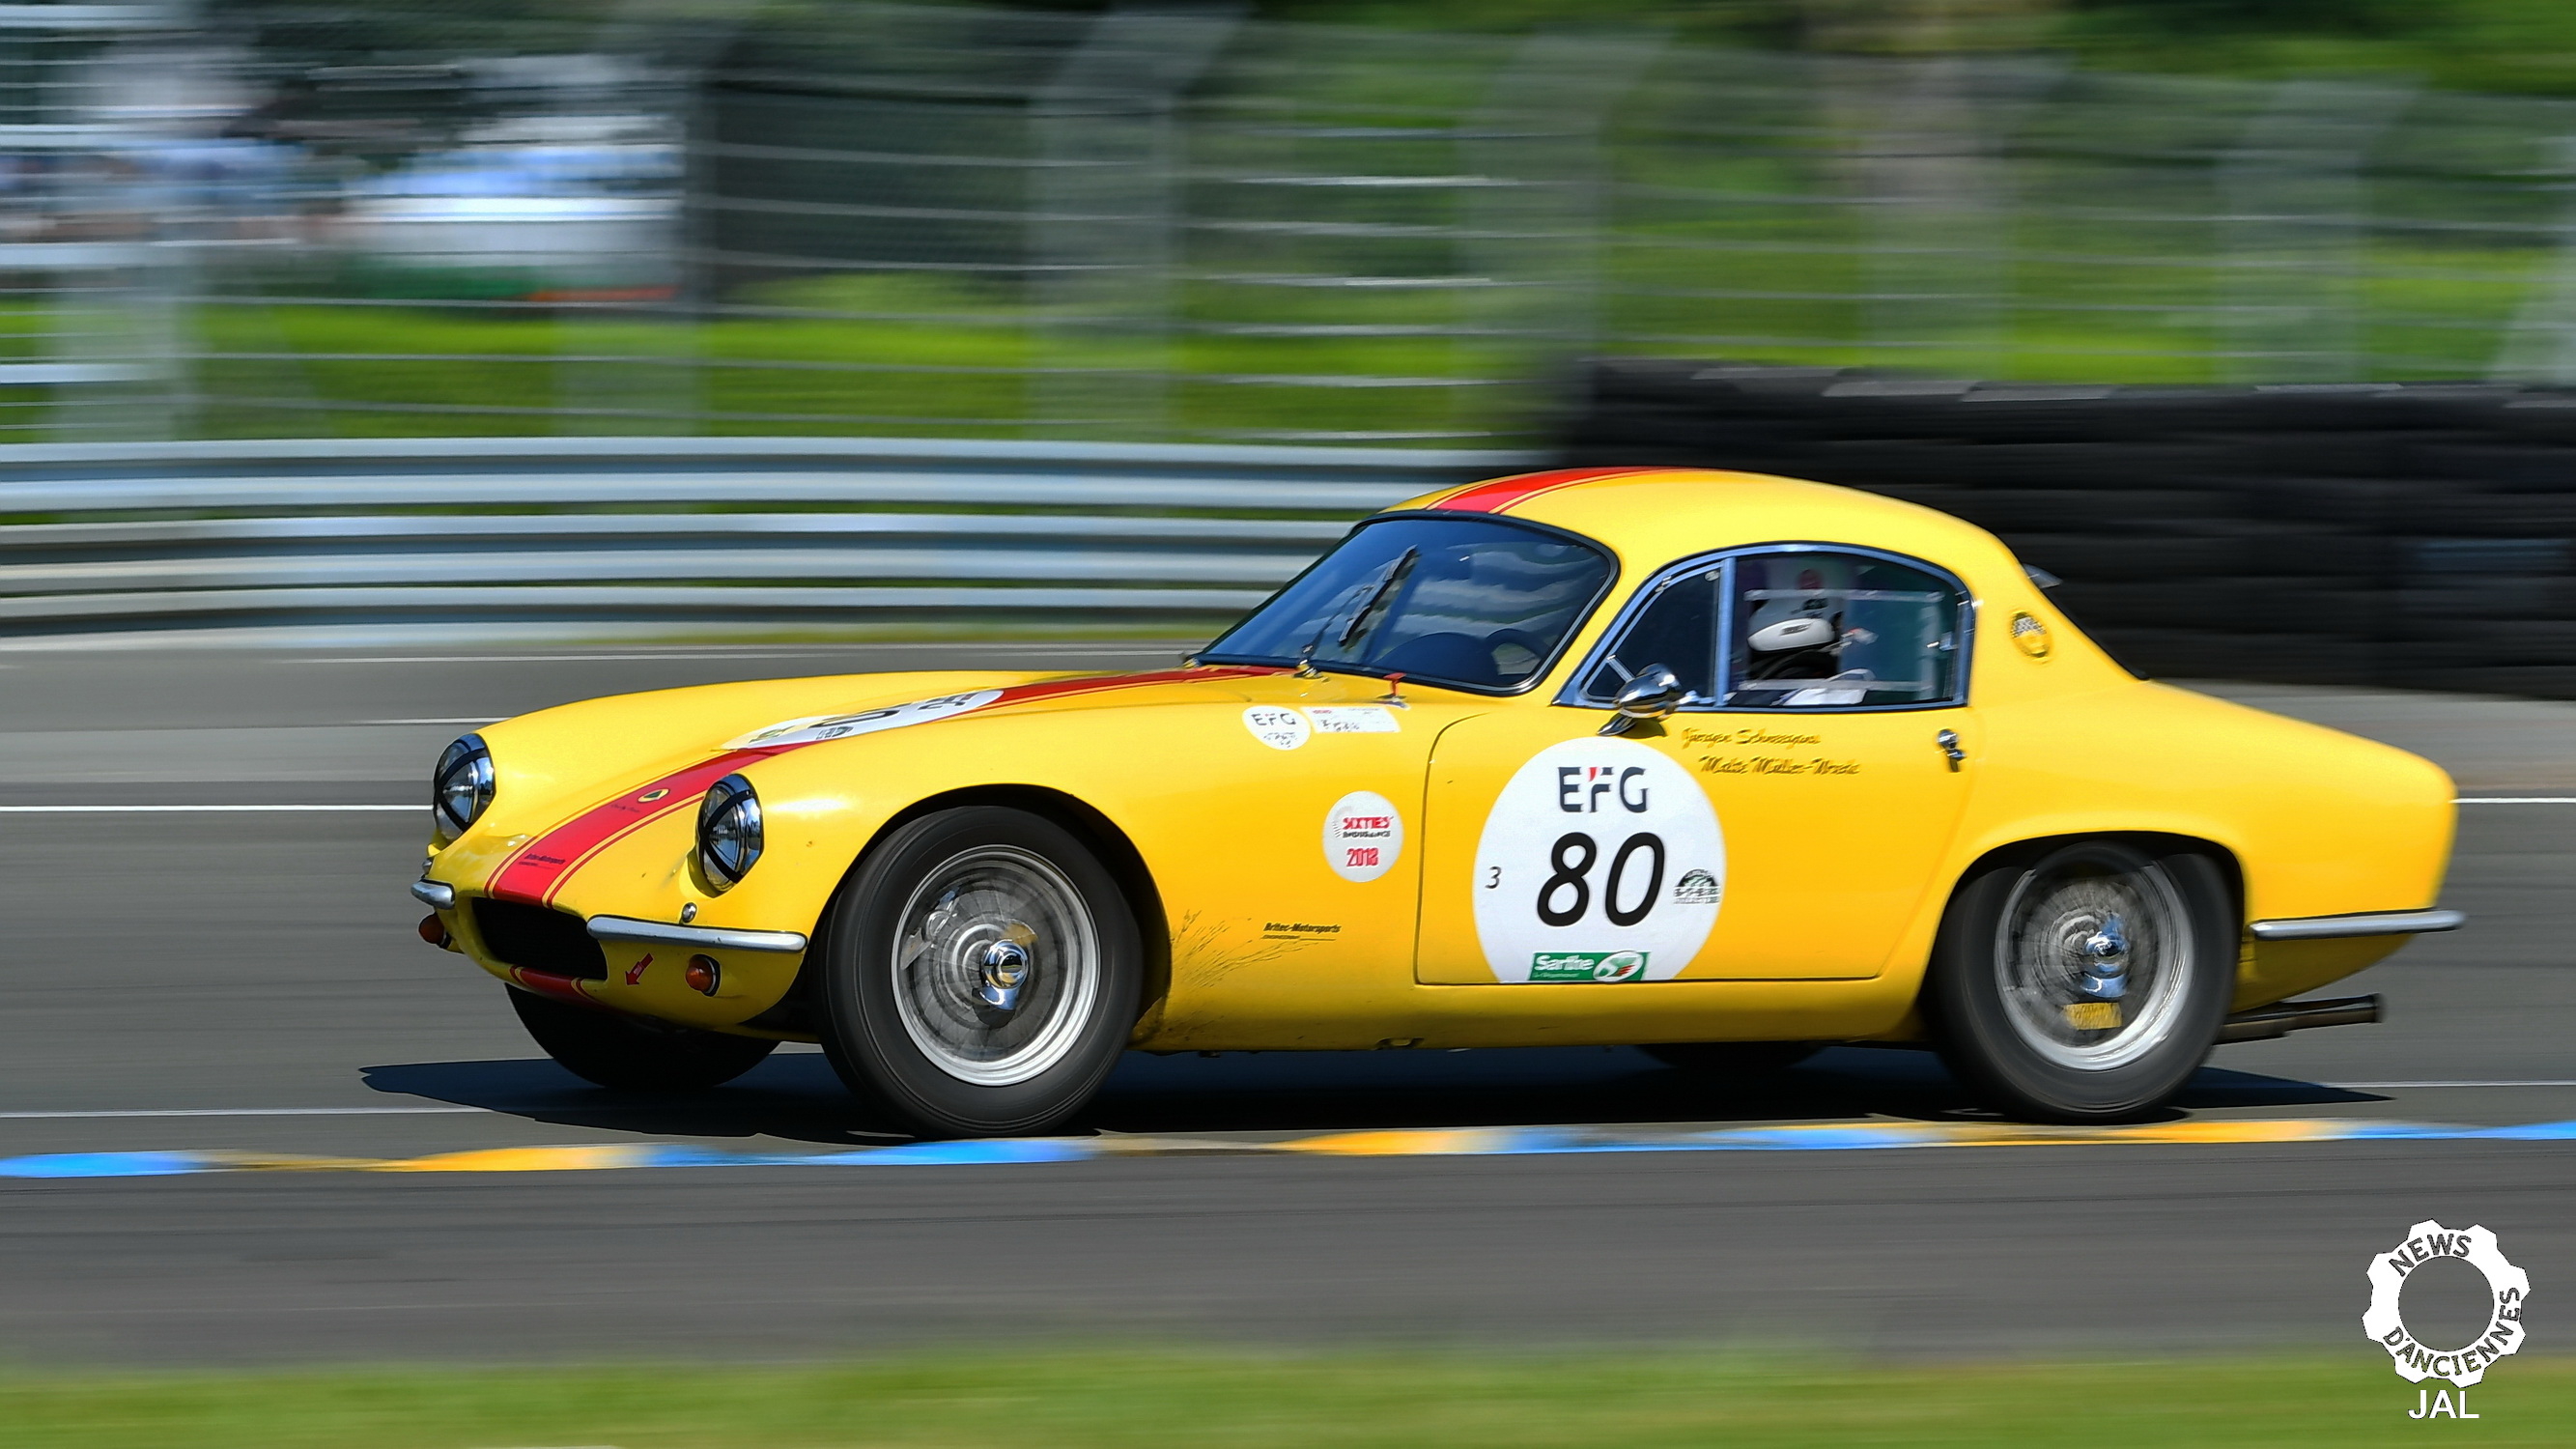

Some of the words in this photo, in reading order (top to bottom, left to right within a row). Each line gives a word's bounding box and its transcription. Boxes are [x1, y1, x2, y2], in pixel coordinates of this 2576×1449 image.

[1557, 767, 1648, 813] EFG
[1345, 847, 1379, 867] 2018
[1485, 867, 1502, 890] 3
[1536, 832, 1665, 927] 80
